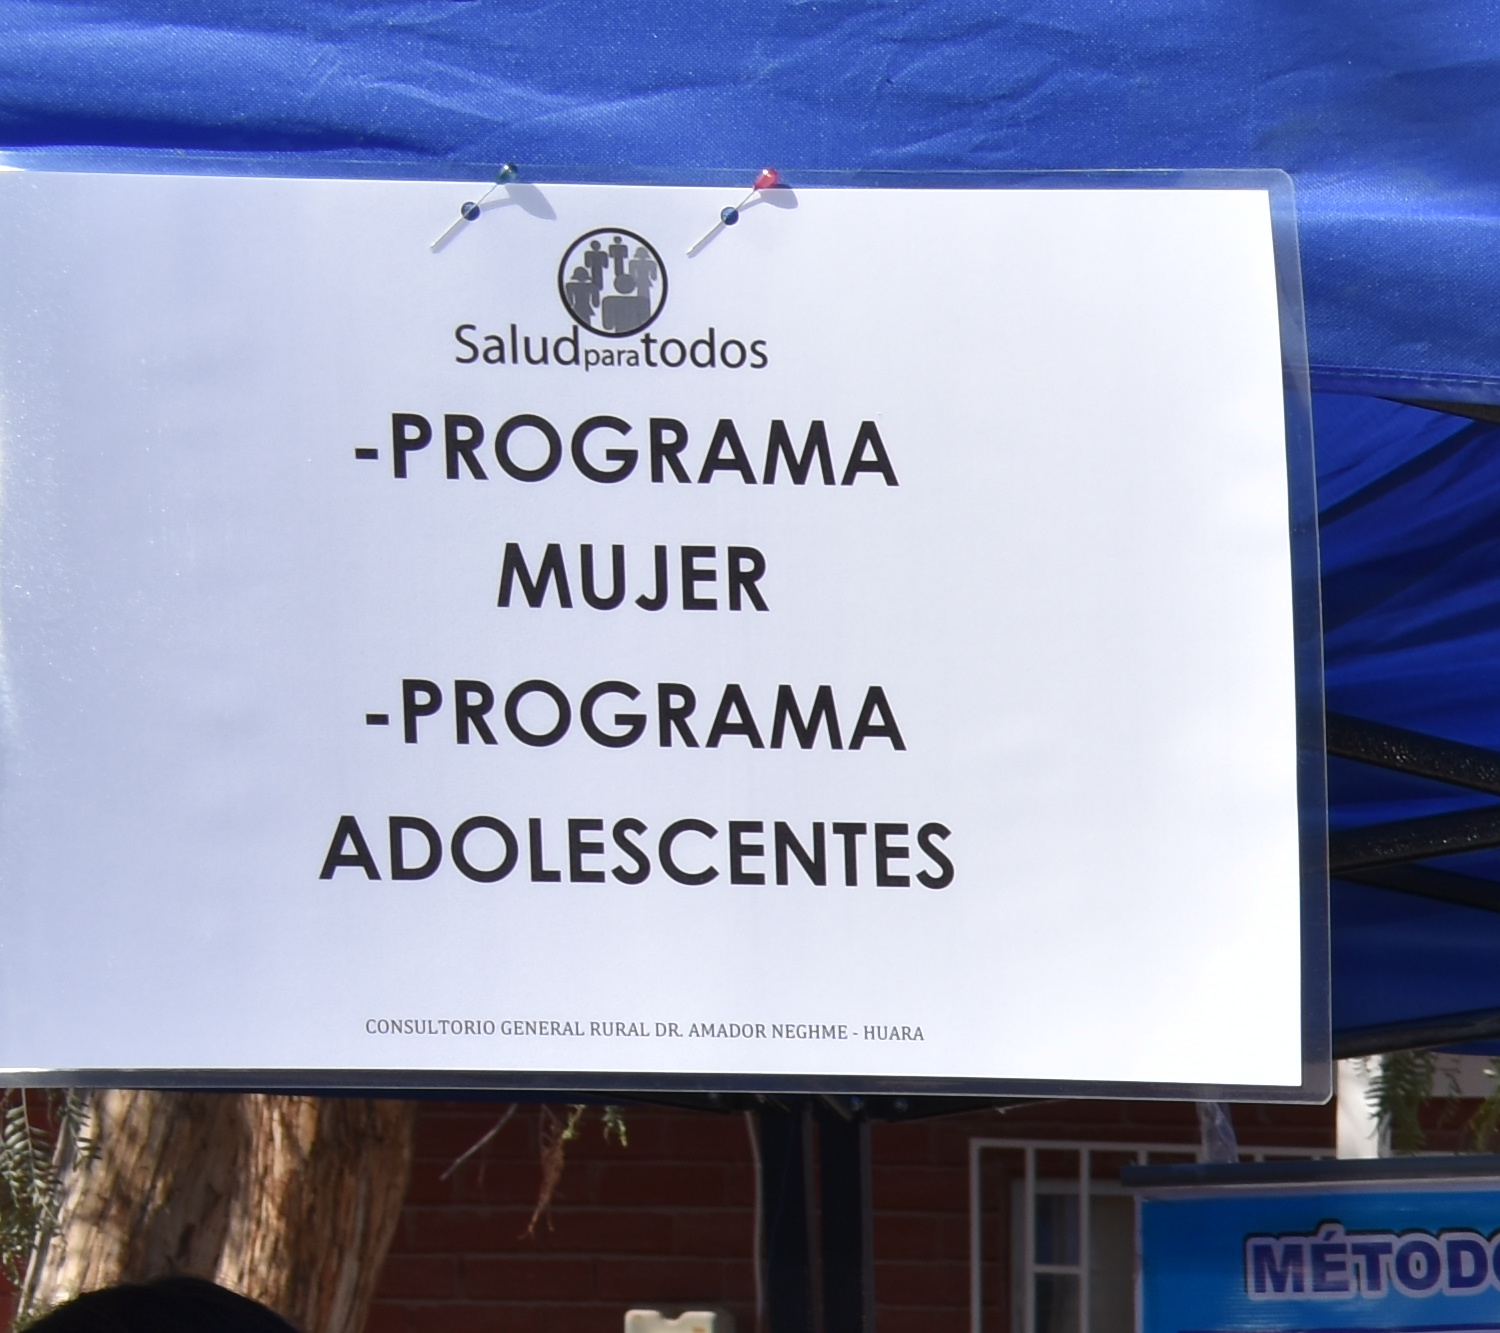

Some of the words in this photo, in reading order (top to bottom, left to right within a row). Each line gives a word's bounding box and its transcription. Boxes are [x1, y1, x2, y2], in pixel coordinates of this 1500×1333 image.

[354, 412, 900, 488] -PROGRAMA
[497, 541, 770, 612] MUJER
[364, 678, 907, 751] -PROGRAMA
[318, 814, 956, 891] ADOLESCENTES
[365, 1019, 496, 1035] CONSULTORIO
[500, 1020, 585, 1036] GENERAL
[589, 1021, 650, 1037] RURAL
[655, 1022, 684, 1038] DR.
[688, 1023, 767, 1039] AMADOR
[771, 1024, 848, 1040] NEGHME
[863, 1025, 925, 1041] HUARA
